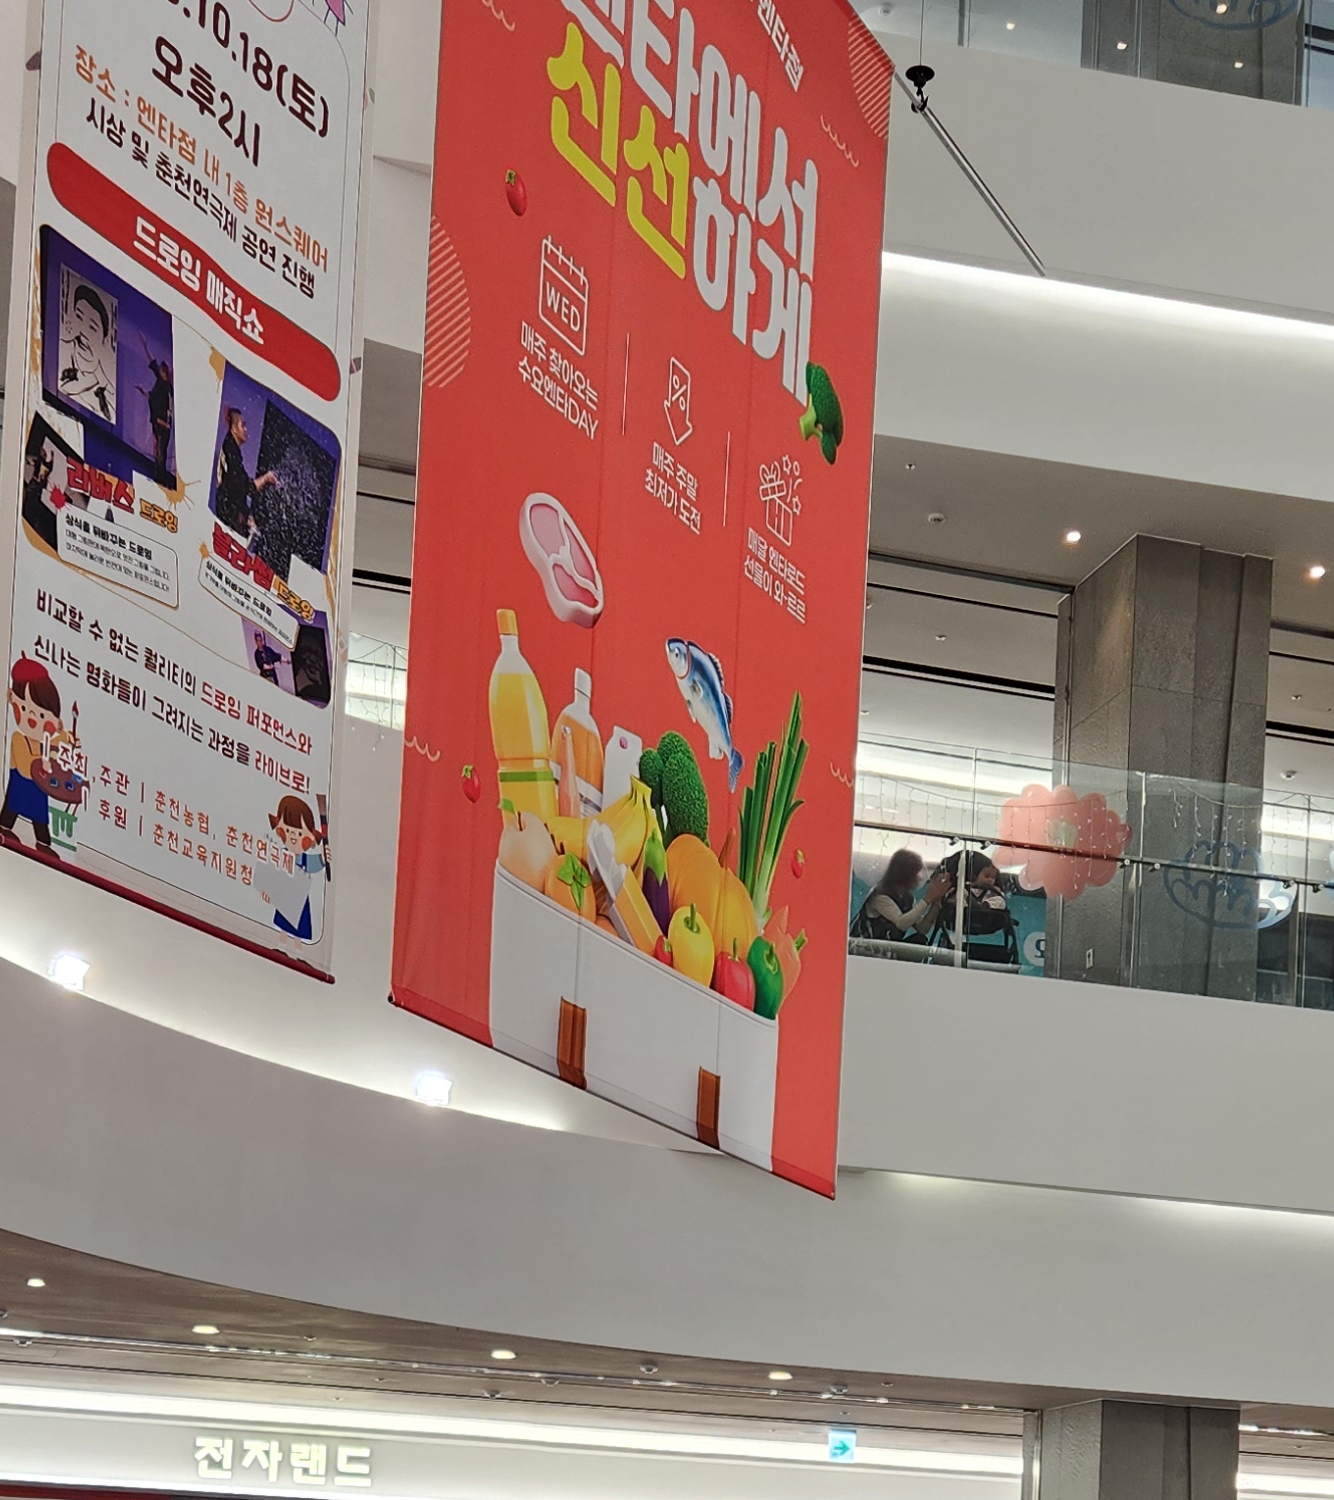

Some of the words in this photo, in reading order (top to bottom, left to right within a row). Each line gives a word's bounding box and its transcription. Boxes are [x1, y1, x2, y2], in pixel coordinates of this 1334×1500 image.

[151, 36, 260, 166] 오후2시
[75, 45, 117, 100] 장소
[203, 148, 219, 187] 내
[225, 172, 248, 214] 1층
[255, 197, 328, 274] 원스퀘어
[86, 97, 127, 149] 시상
[130, 131, 151, 170] 및
[155, 150, 238, 244] 춘천연극제
[241, 227, 277, 275] 공연
[281, 253, 316, 300] 진행
[133, 216, 202, 292] 드로잉
[206, 269, 265, 347] 매직쇼
[546, 280, 581, 330] WED
[521, 320, 547, 363] 매주
[549, 347, 599, 412] 찾아오는
[67, 456, 135, 515] 리버스
[139, 498, 178, 534] 드로잉
[644, 468, 679, 517] 최저가
[679, 497, 702, 536] 도전
[652, 441, 675, 478] 매주
[676, 462, 699, 502] 주말
[744, 555, 774, 598] 선물이
[747, 526, 768, 563] 매달
[277, 581, 315, 623] 드로잉
[36, 587, 85, 633] 비교할
[88, 619, 104, 641] 수
[108, 628, 139, 662] 없는
[144, 646, 197, 696] 퀄리티의
[200, 680, 242, 720] 드로잉
[246, 704, 313, 756] 퍼포먼스와
[33, 634, 81, 678] 신나는
[86, 660, 147, 712] 명화들이
[151, 695, 204, 743] 그려지는
[208, 727, 252, 766] 과정을
[253, 750, 311, 795] 라이브로!
[98, 799, 127, 830] 후원
[152, 822, 254, 886] 춘천교육지원청
[225, 825, 295, 875] 춘천연극제
[194, 1435, 373, 1488] 전자랜드
